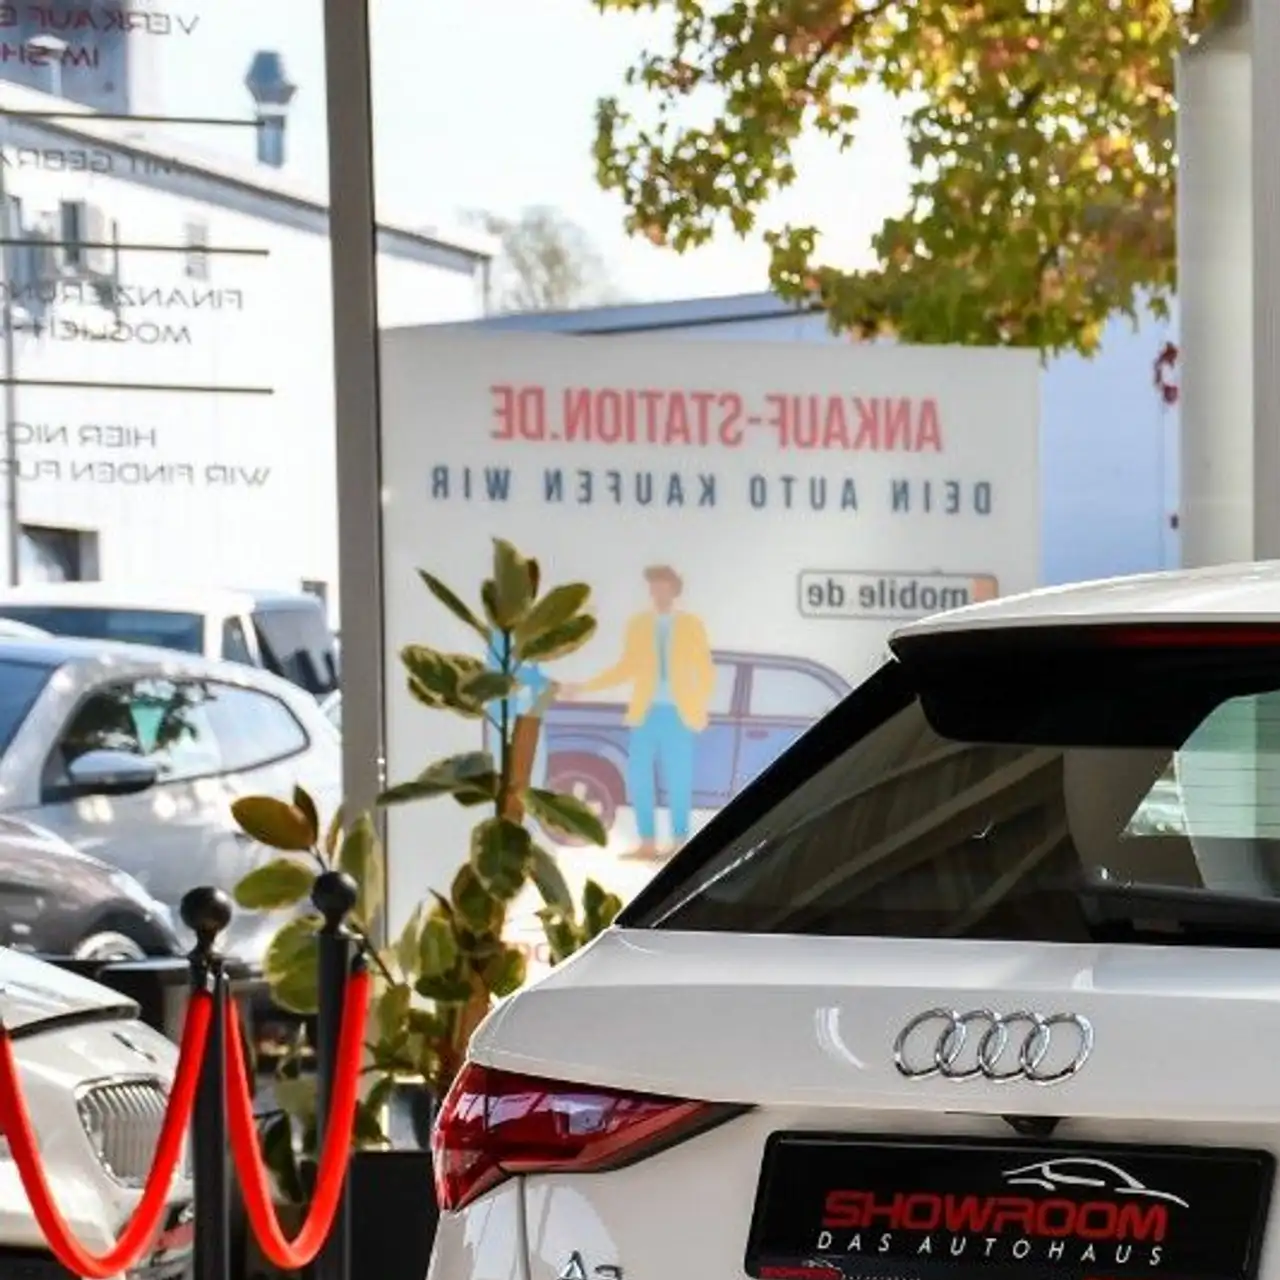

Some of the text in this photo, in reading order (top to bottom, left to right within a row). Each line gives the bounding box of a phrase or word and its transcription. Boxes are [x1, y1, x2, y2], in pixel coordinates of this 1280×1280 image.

[821, 1190, 1172, 1241] SHOWROOM
[816, 1230, 1165, 1266] DAS AUTOHAUS
